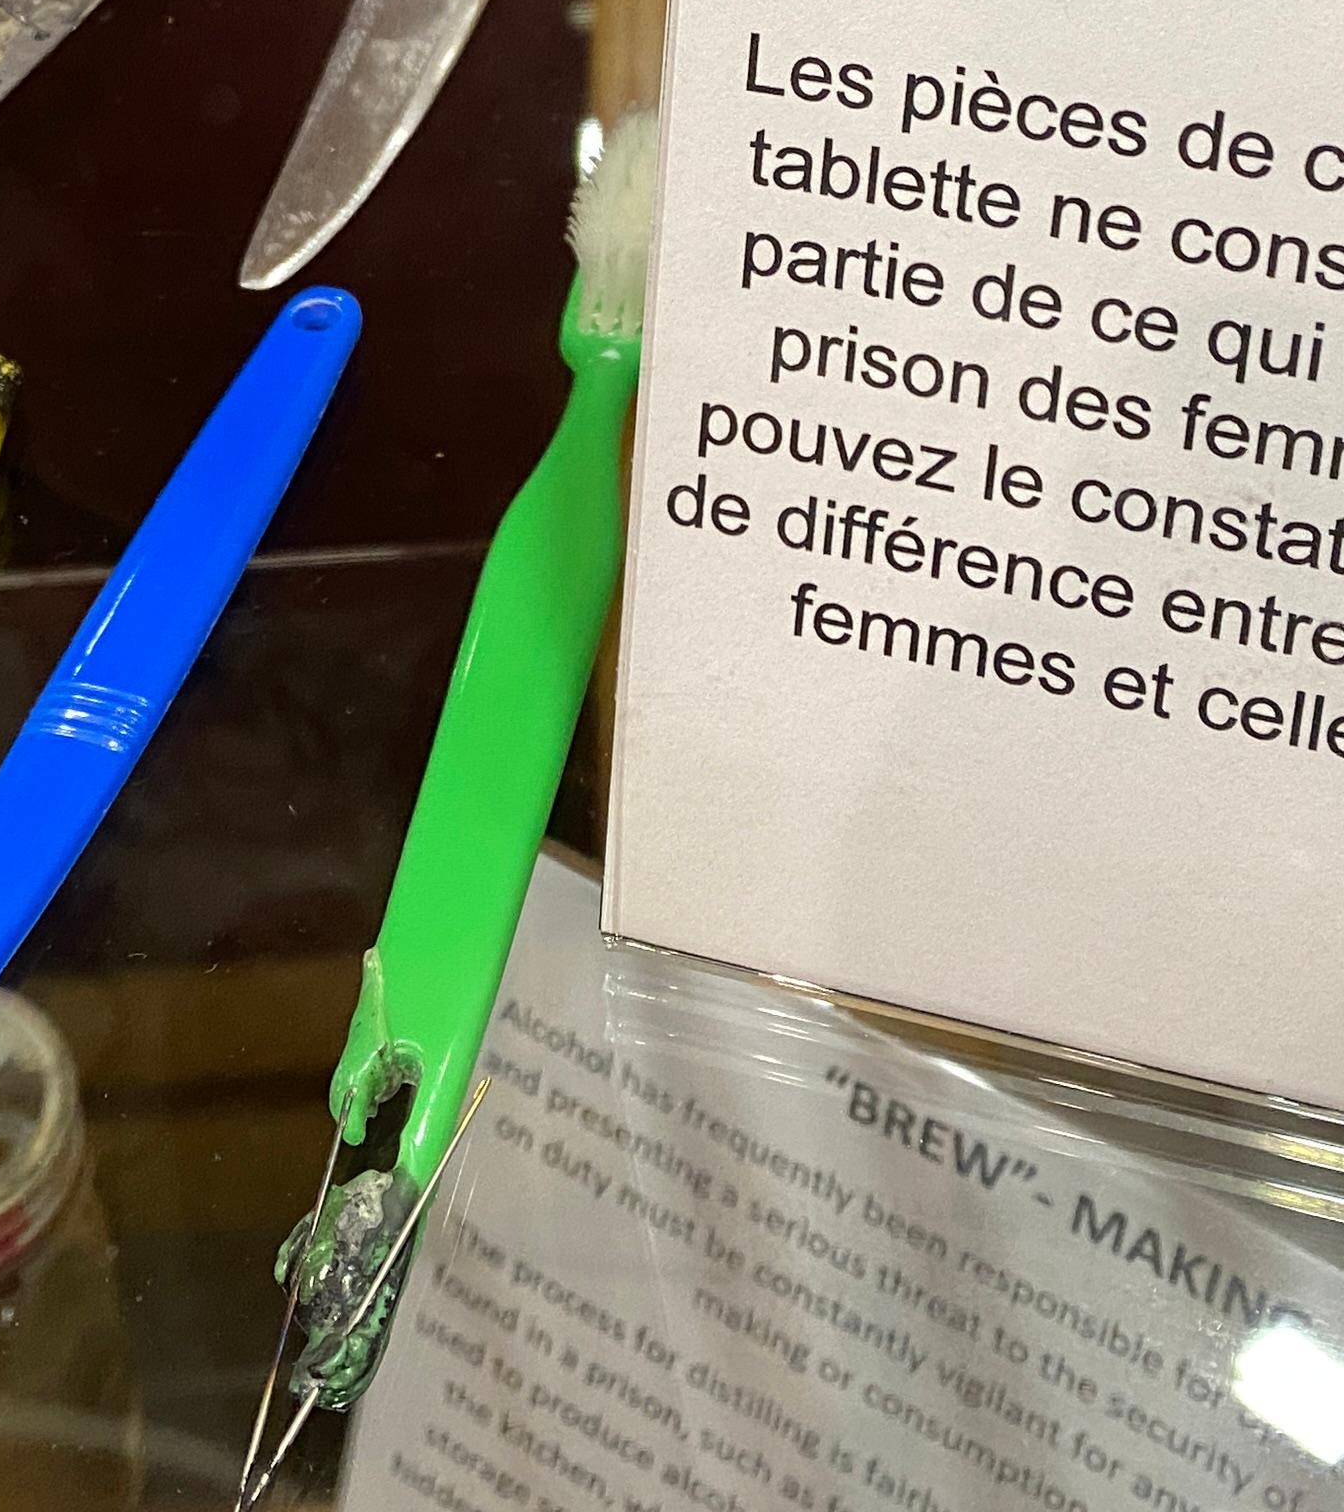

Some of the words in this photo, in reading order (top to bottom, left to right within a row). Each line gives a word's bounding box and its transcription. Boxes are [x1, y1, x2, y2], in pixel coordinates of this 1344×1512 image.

[745, 31, 874, 111] Les
[900, 64, 1148, 158] pièces
[1177, 109, 1275, 180] de
[748, 128, 1022, 230] tablette
[1048, 193, 1142, 252] ne
[740, 230, 945, 308] partie
[971, 262, 1063, 331] de
[1090, 297, 1179, 353] ce
[1207, 319, 1324, 385] qui
[769, 324, 990, 410] prison
[1017, 364, 1153, 441] des
[697, 401, 959, 494] pouvez
[982, 442, 1044, 510] le
[665, 472, 752, 537] de
[776, 494, 1135, 620] différence
[789, 581, 1077, 697] femmes
[1102, 662, 1175, 720] et
[484, 1050, 543, 1096] and
[544, 1088, 713, 1201] presenting
[749, 1200, 866, 1281] serious
[876, 1263, 980, 1342] threat
[992, 1327, 1029, 1364] to
[1038, 1352, 1099, 1405] the
[1104, 1392, 1255, 1496] security
[498, 1000, 614, 1079] Alcohol
[620, 1061, 674, 1114] has
[682, 1097, 855, 1215] frequently
[861, 1190, 949, 1261] been
[958, 1252, 1164, 1374] responsible
[1173, 1354, 1224, 1408] for
[1069, 1193, 1314, 1328] MAKIN
[495, 1116, 534, 1153] on
[541, 1140, 612, 1199] duty
[616, 1185, 696, 1246] must
[703, 1229, 746, 1273] be
[755, 1263, 928, 1376] constantly
[936, 1360, 1060, 1449] vigilant
[1071, 1431, 1125, 1480] for
[512, 1260, 626, 1341] process
[635, 1325, 678, 1371] for
[686, 1362, 820, 1460] distilling
[692, 1287, 809, 1374] making
[818, 1357, 854, 1390] or
[529, 1383, 655, 1471] produce
[699, 1426, 772, 1485] such
